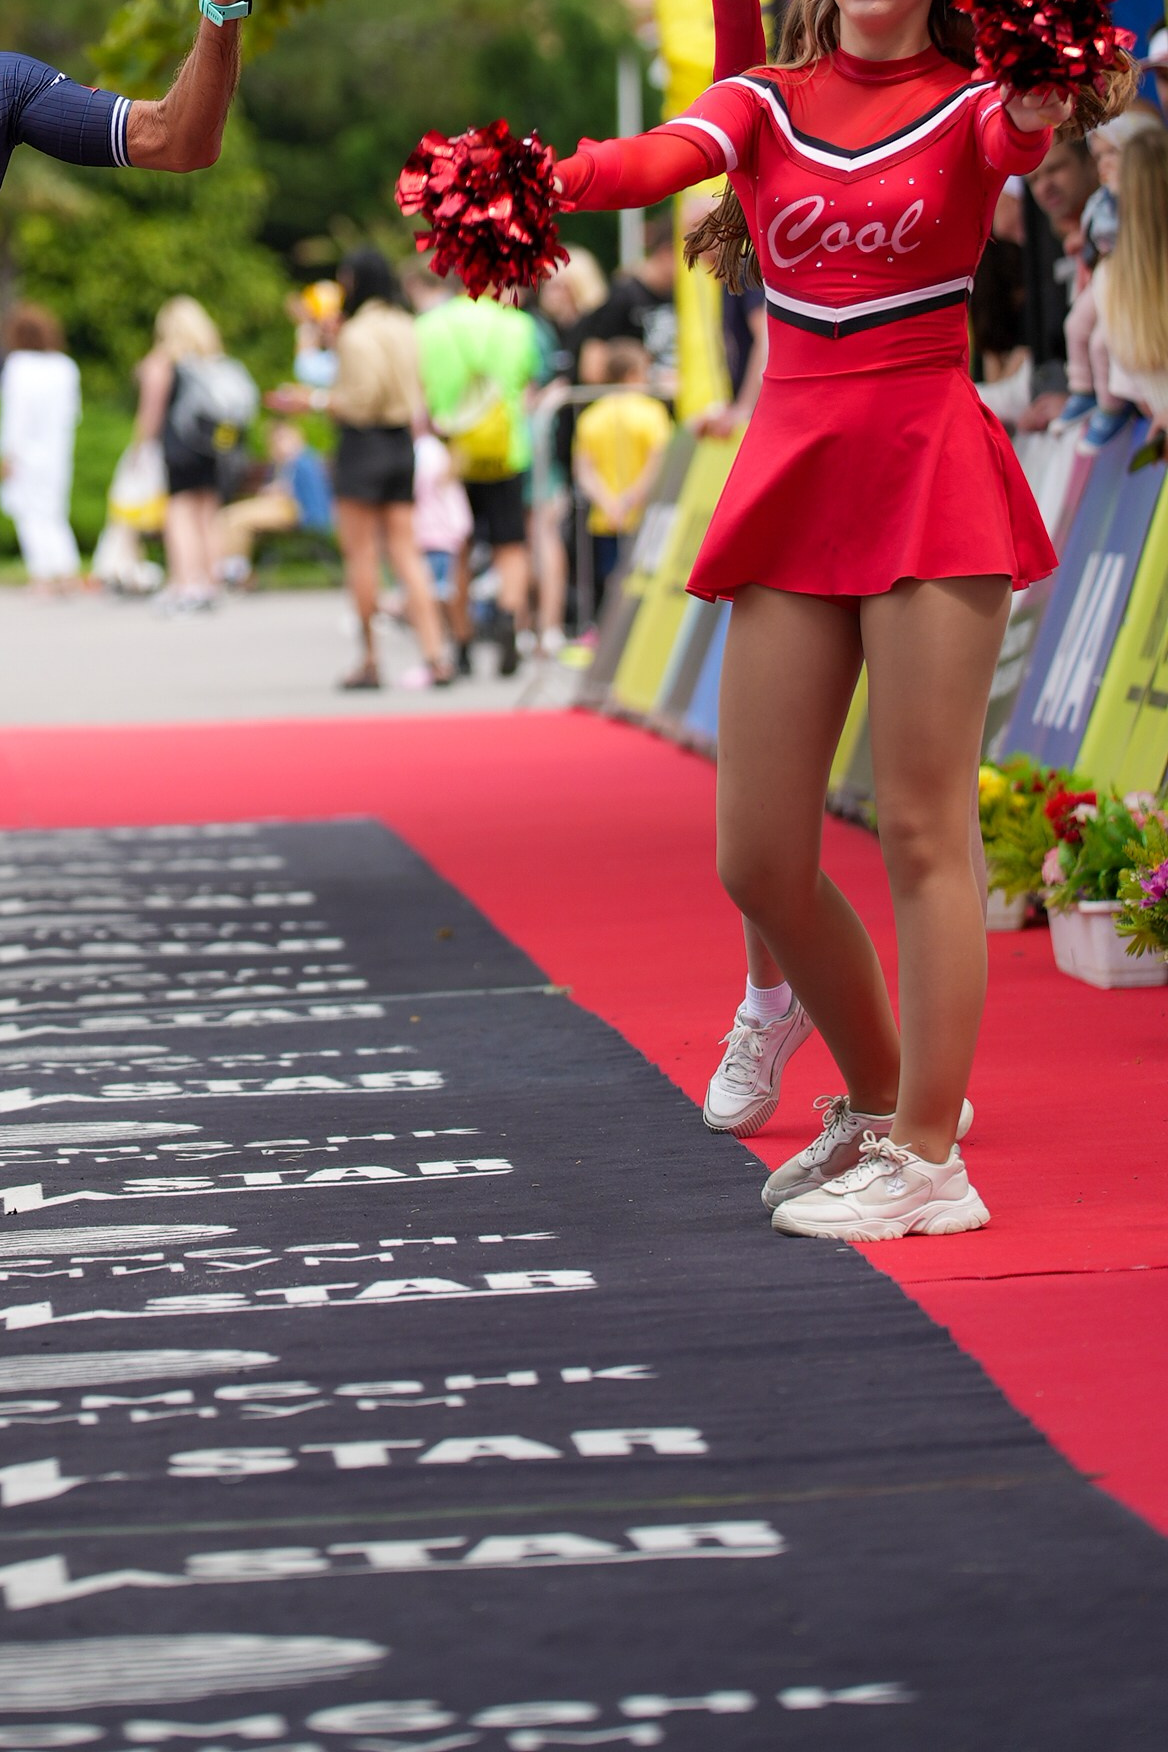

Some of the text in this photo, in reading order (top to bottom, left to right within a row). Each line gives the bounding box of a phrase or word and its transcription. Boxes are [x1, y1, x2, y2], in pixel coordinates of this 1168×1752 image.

[767, 195, 924, 269] Cool
[101, 1069, 445, 1098] STAR
[123, 1158, 514, 1194] STAR
[144, 1269, 599, 1313] STAR
[167, 1427, 710, 1479] STAR
[185, 1519, 785, 1578] STAR
